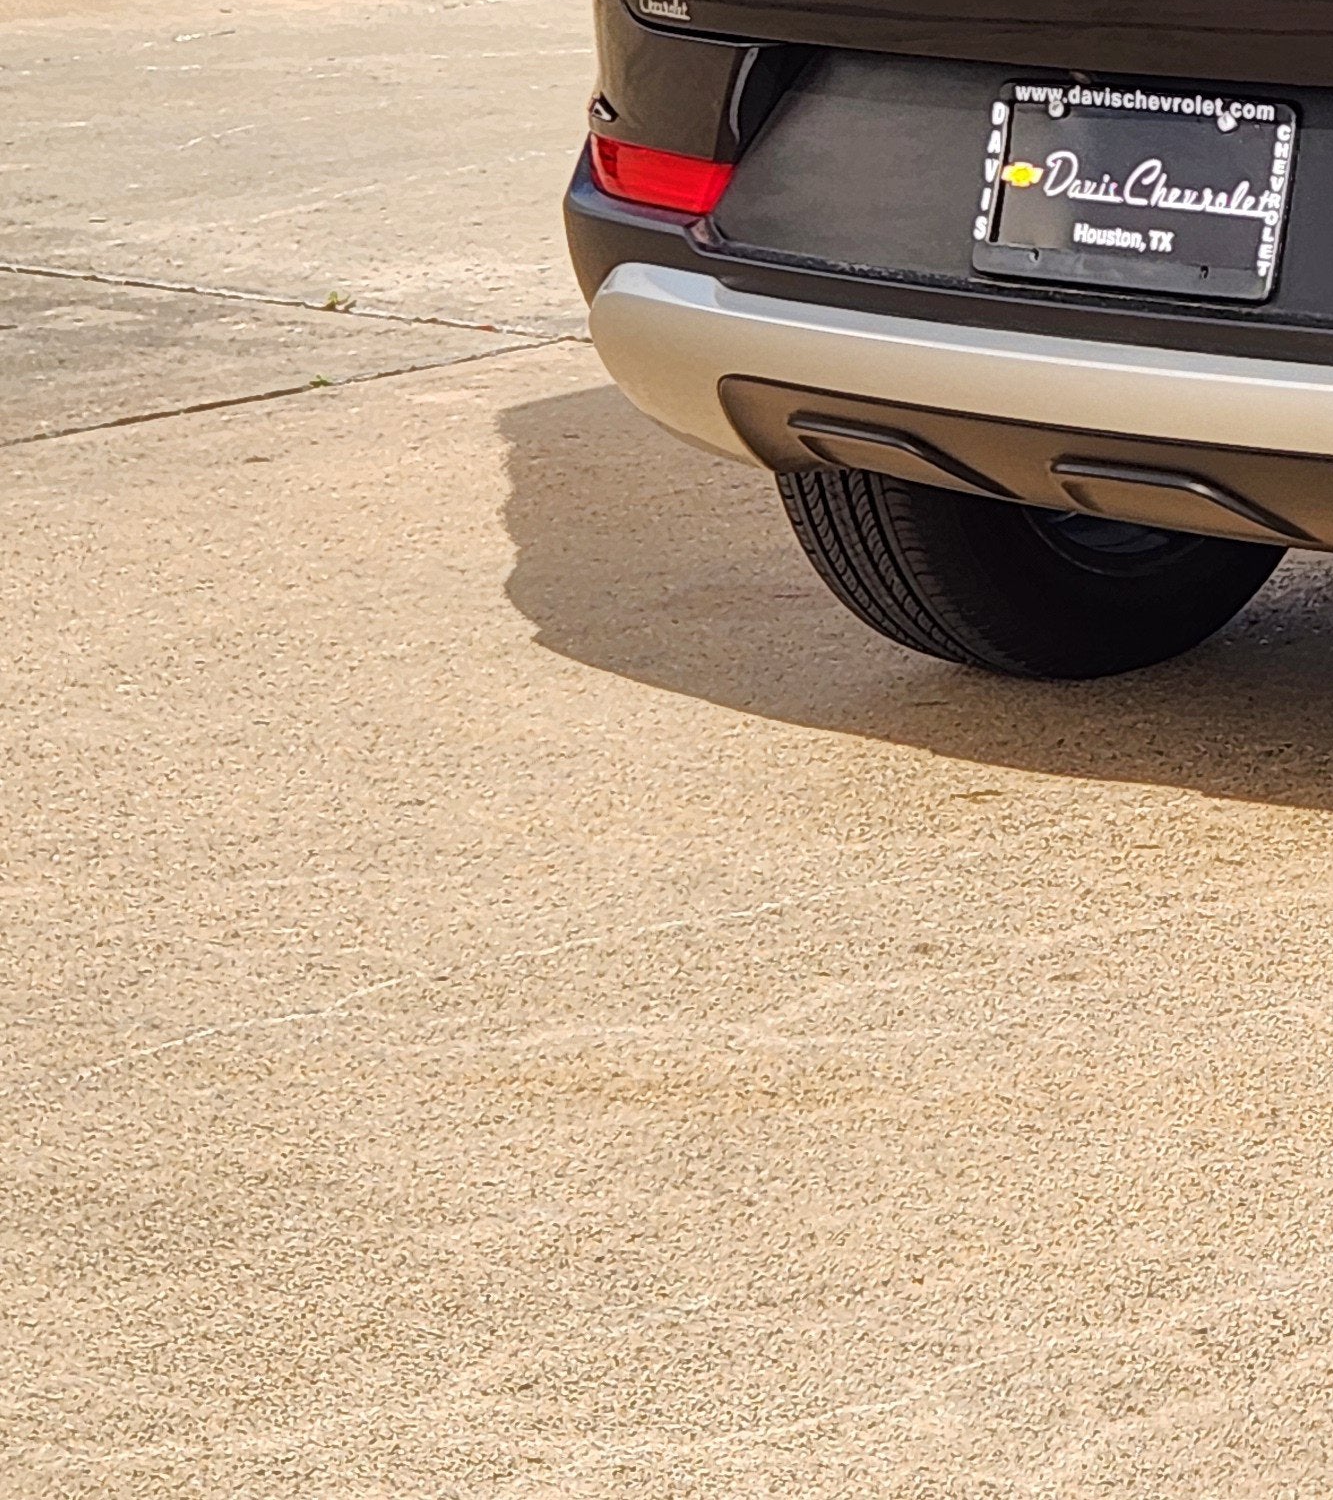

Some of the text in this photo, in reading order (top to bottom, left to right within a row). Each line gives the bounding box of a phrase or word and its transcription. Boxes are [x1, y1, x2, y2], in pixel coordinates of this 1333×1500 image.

[1015, 85, 1275, 121] www.davischevrolet.com
[973, 101, 1008, 240] DAVIS
[1043, 150, 1270, 218] Davis Chevrolet
[1257, 124, 1293, 276] CHEVROLET
[1073, 222, 1175, 253] Houston, TX
